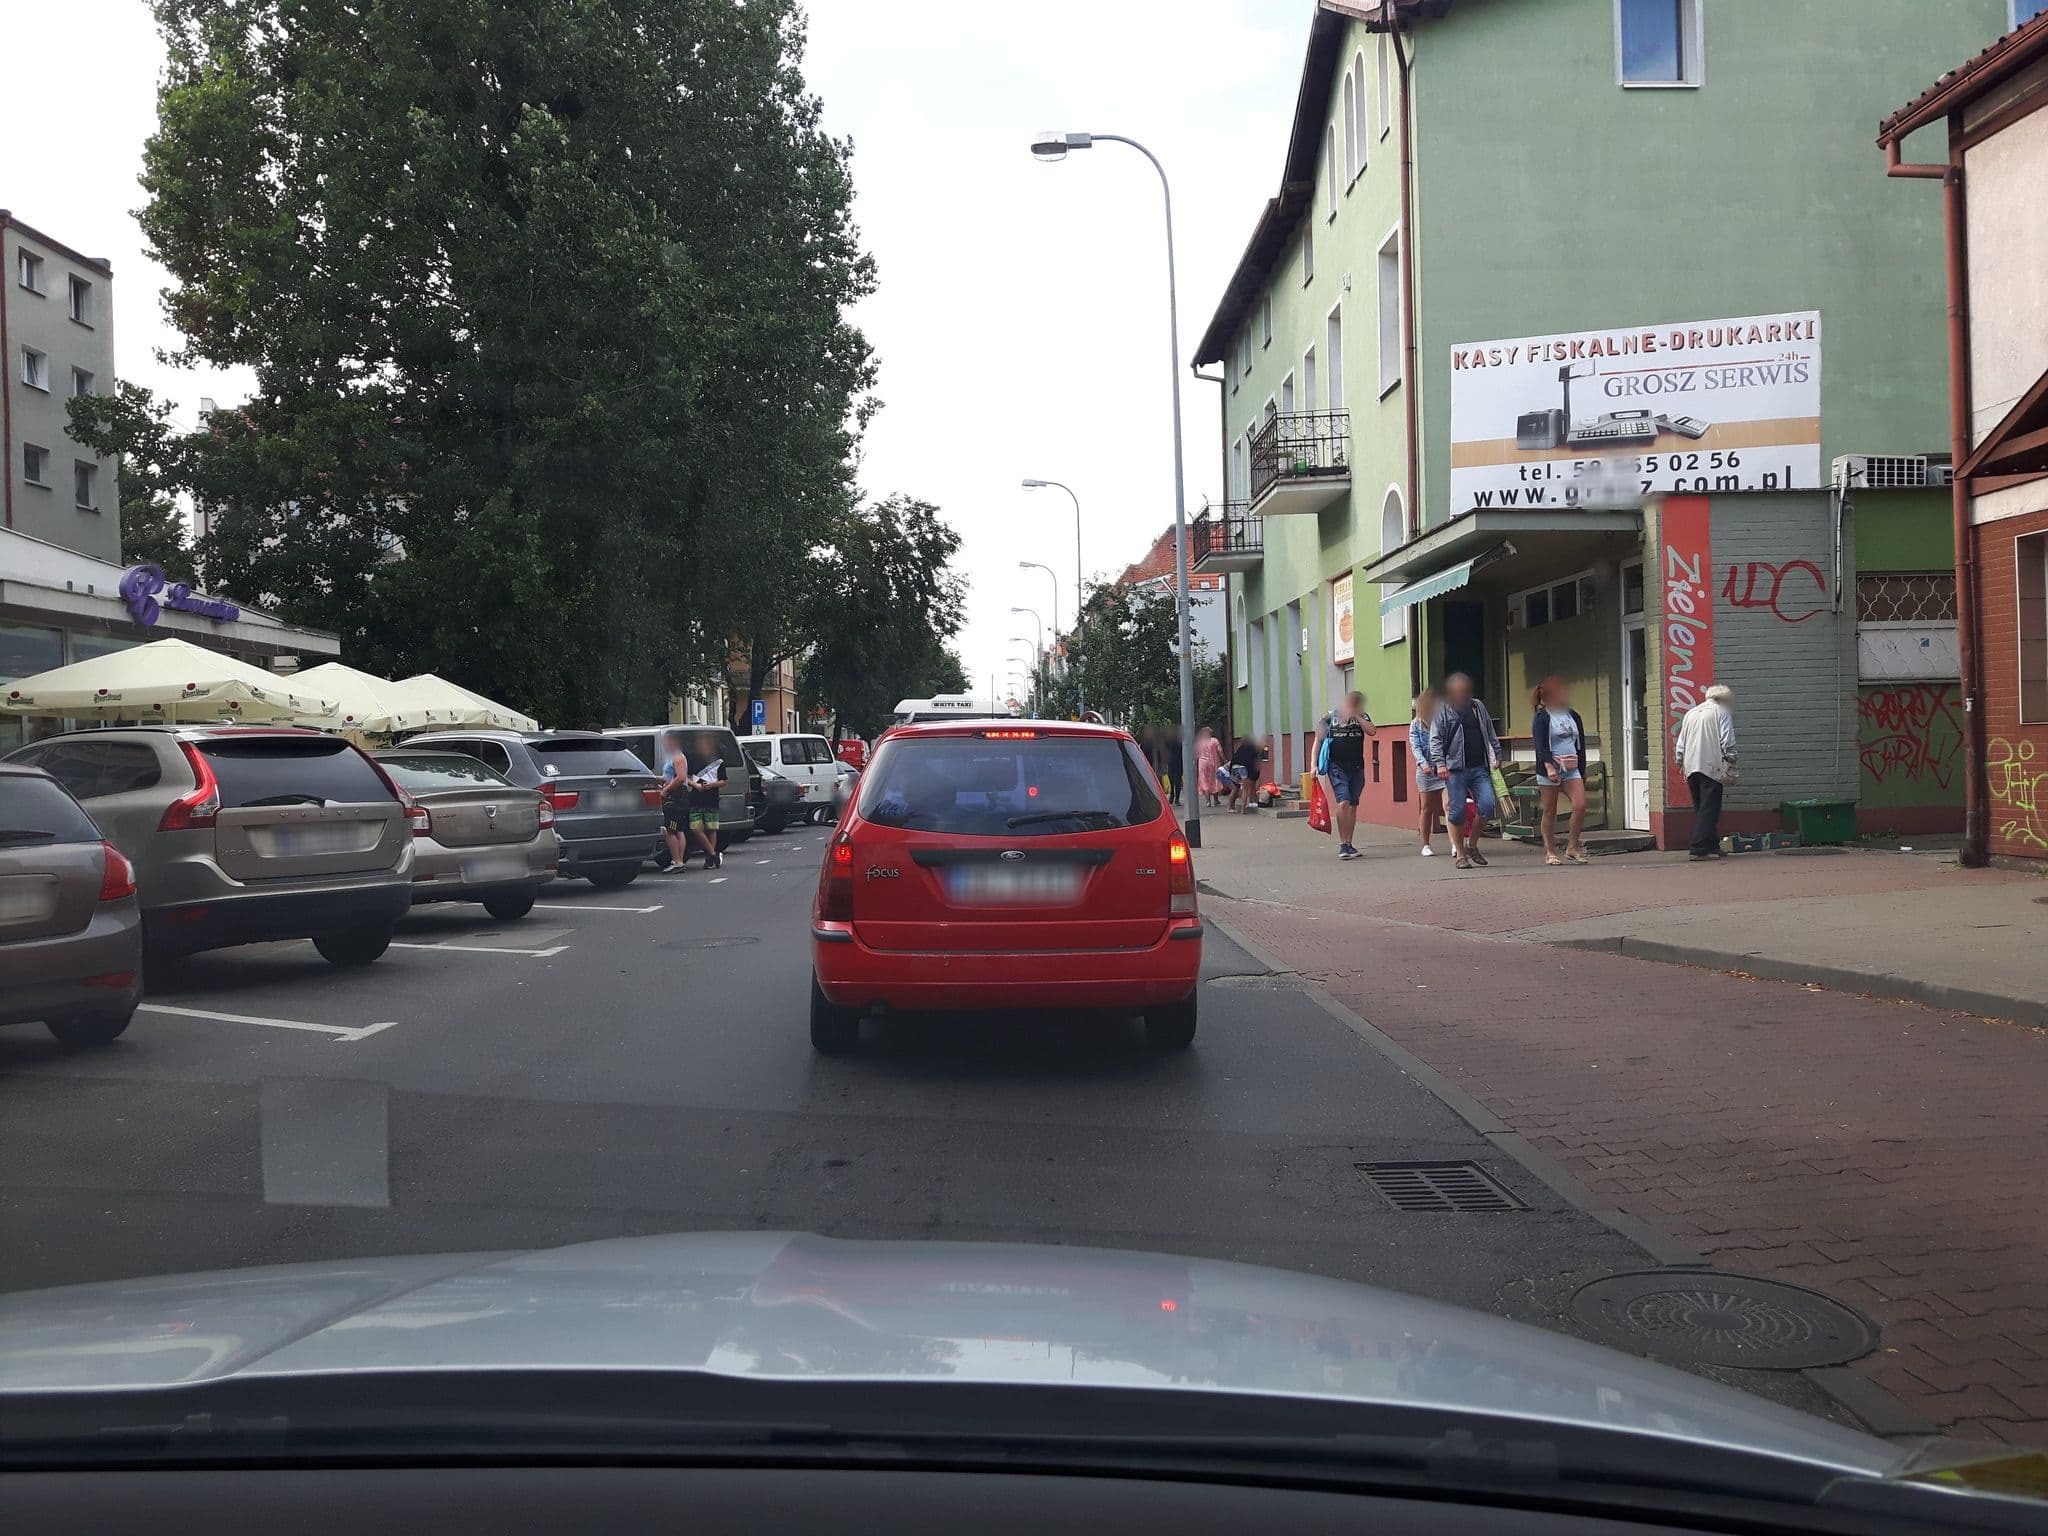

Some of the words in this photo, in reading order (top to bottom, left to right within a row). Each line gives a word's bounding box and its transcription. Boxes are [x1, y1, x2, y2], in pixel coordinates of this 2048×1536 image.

[1453, 346, 1519, 370] KASY
[1527, 319, 1816, 363] FISKALNE-DRUKARKI
[1777, 351, 1800, 362] 24h
[1603, 371, 1696, 398] GROSZ
[1704, 362, 1809, 390] SERWIS
[1519, 463, 1562, 481] tel.
[1669, 453, 1699, 471] 02
[1710, 451, 1740, 469] 56
[755, 702, 763, 717] P
